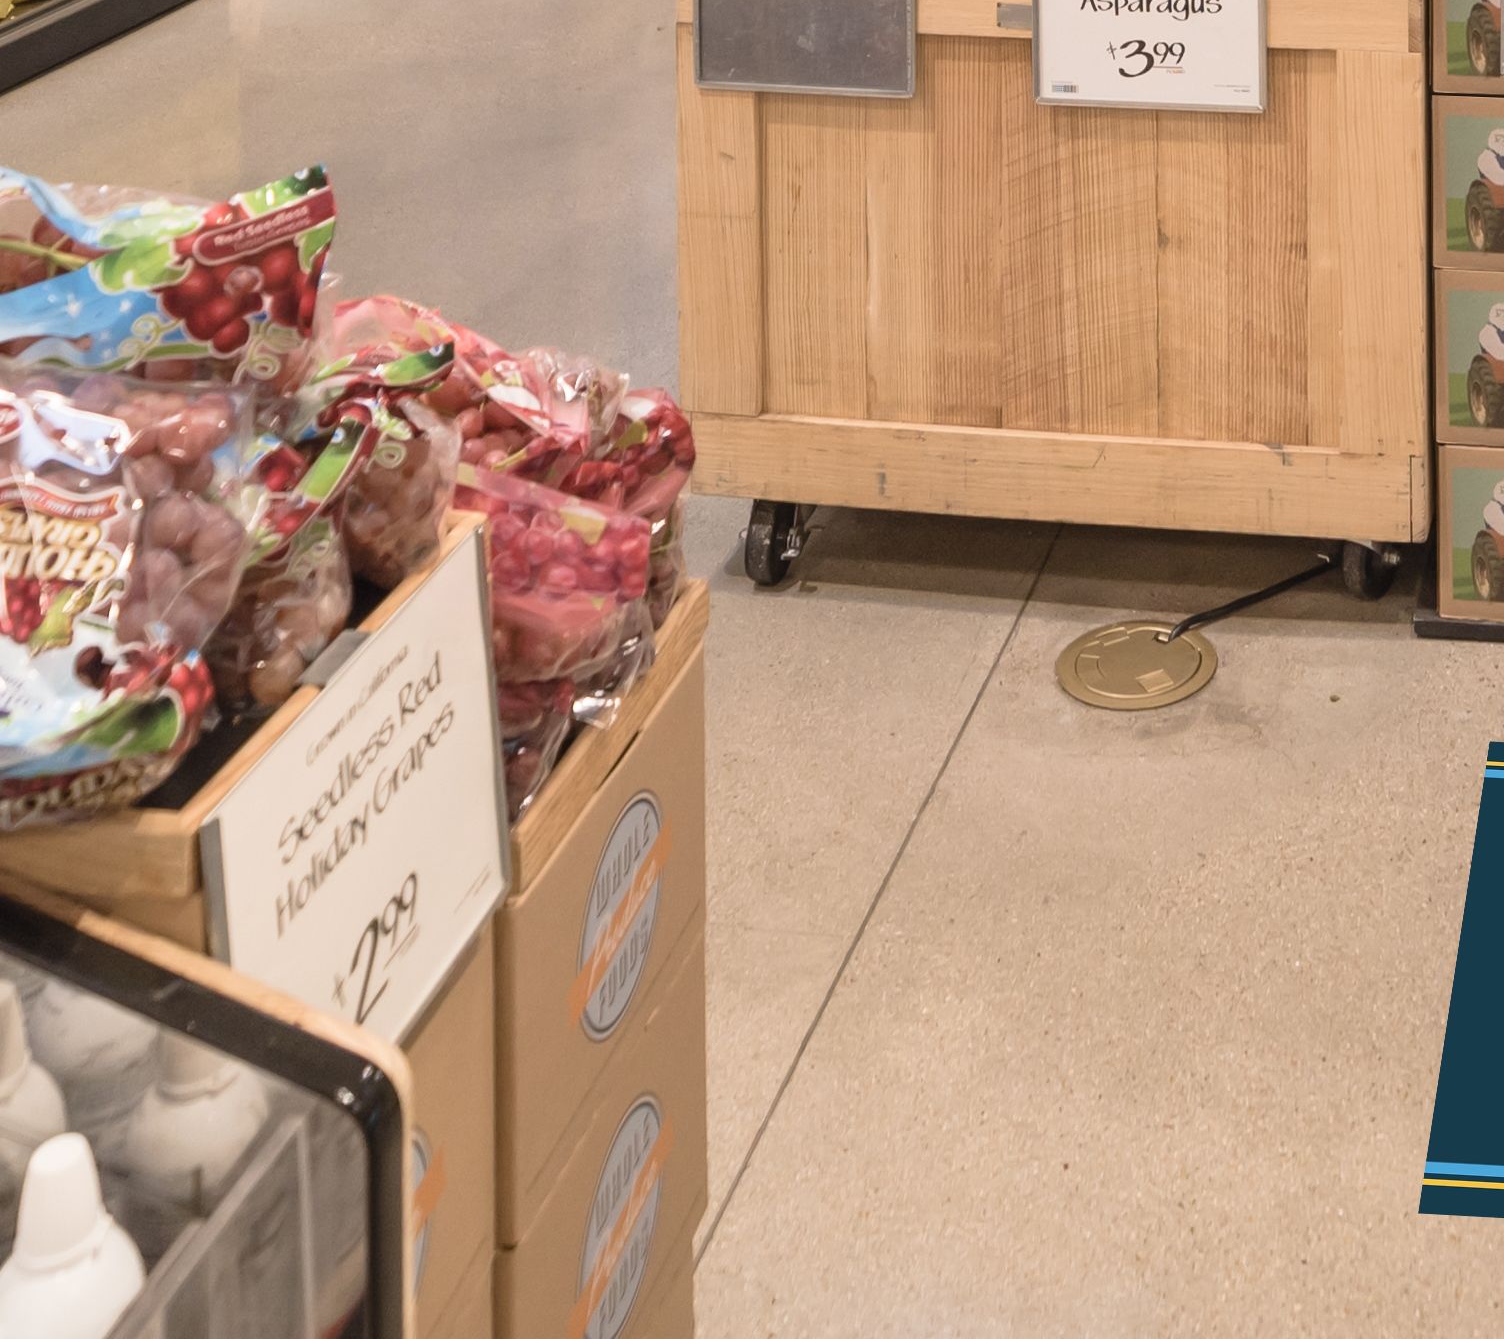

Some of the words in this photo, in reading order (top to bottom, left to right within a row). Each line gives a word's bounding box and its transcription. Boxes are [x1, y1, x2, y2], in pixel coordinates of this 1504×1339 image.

[275, 802, 370, 939] Holiday
[372, 701, 455, 815] Grapes
[278, 712, 396, 865] Seedless
[399, 651, 443, 726] Red
